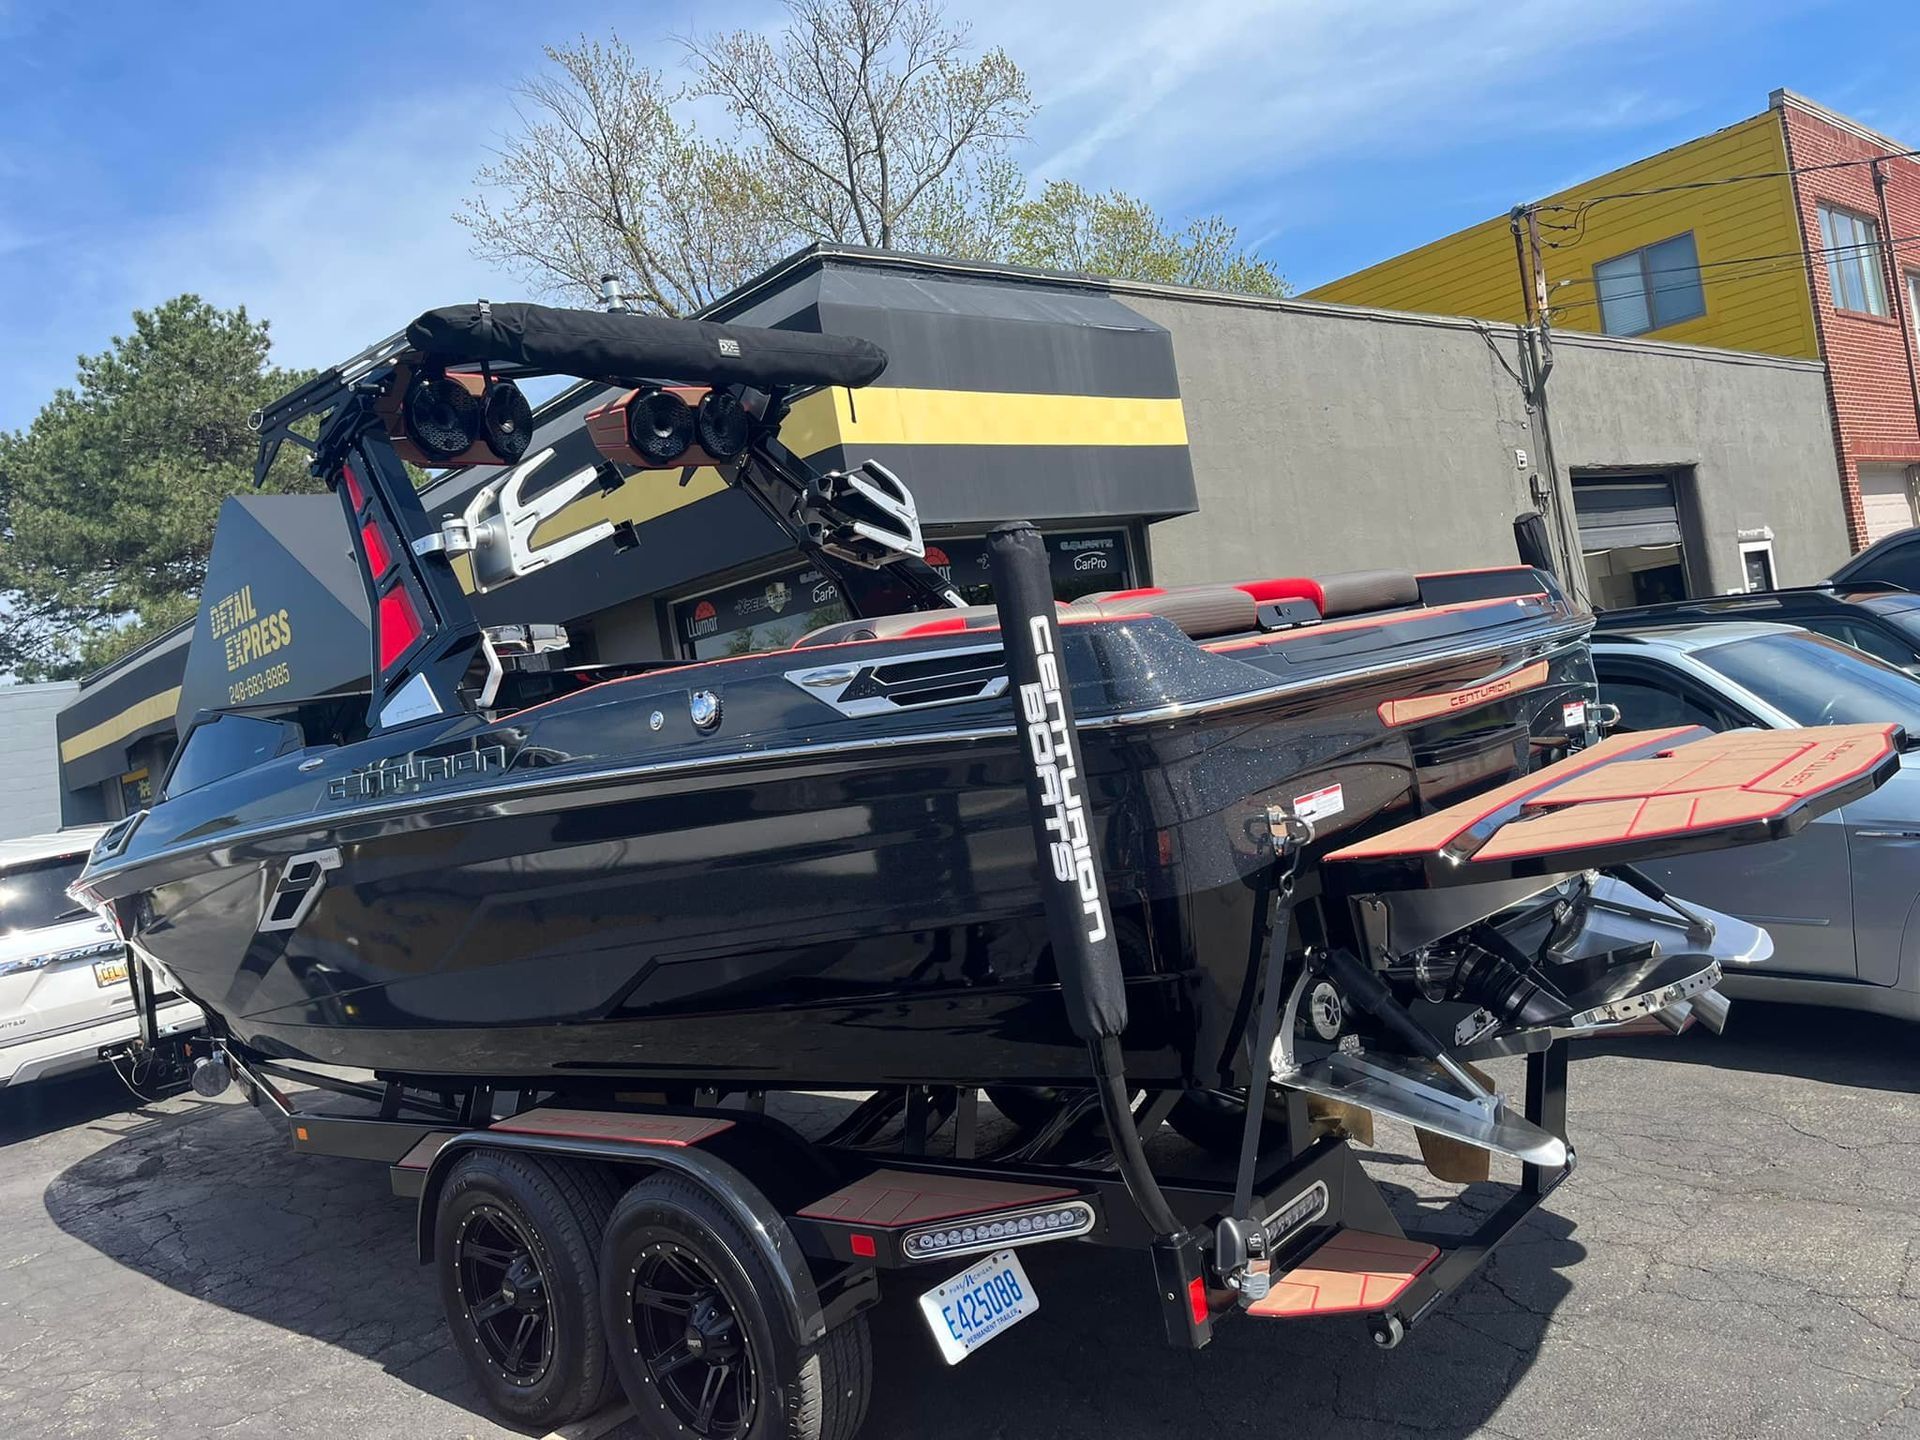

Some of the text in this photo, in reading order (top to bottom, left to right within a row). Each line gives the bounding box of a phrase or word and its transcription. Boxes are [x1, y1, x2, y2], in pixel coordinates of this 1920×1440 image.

[1074, 557, 1107, 571] CarPro
[210, 585, 257, 640] DETAIL
[225, 609, 291, 672] EXPRESS
[229, 662, 290, 704] 248-683-8885
[1450, 681, 1512, 707] CENTURION
[1020, 682, 1077, 882] BOATS
[1029, 615, 1106, 943] CENTURION
[942, 1269, 1023, 1341] E425088
[967, 1308, 1018, 1345] PERMANENT TRAILER
